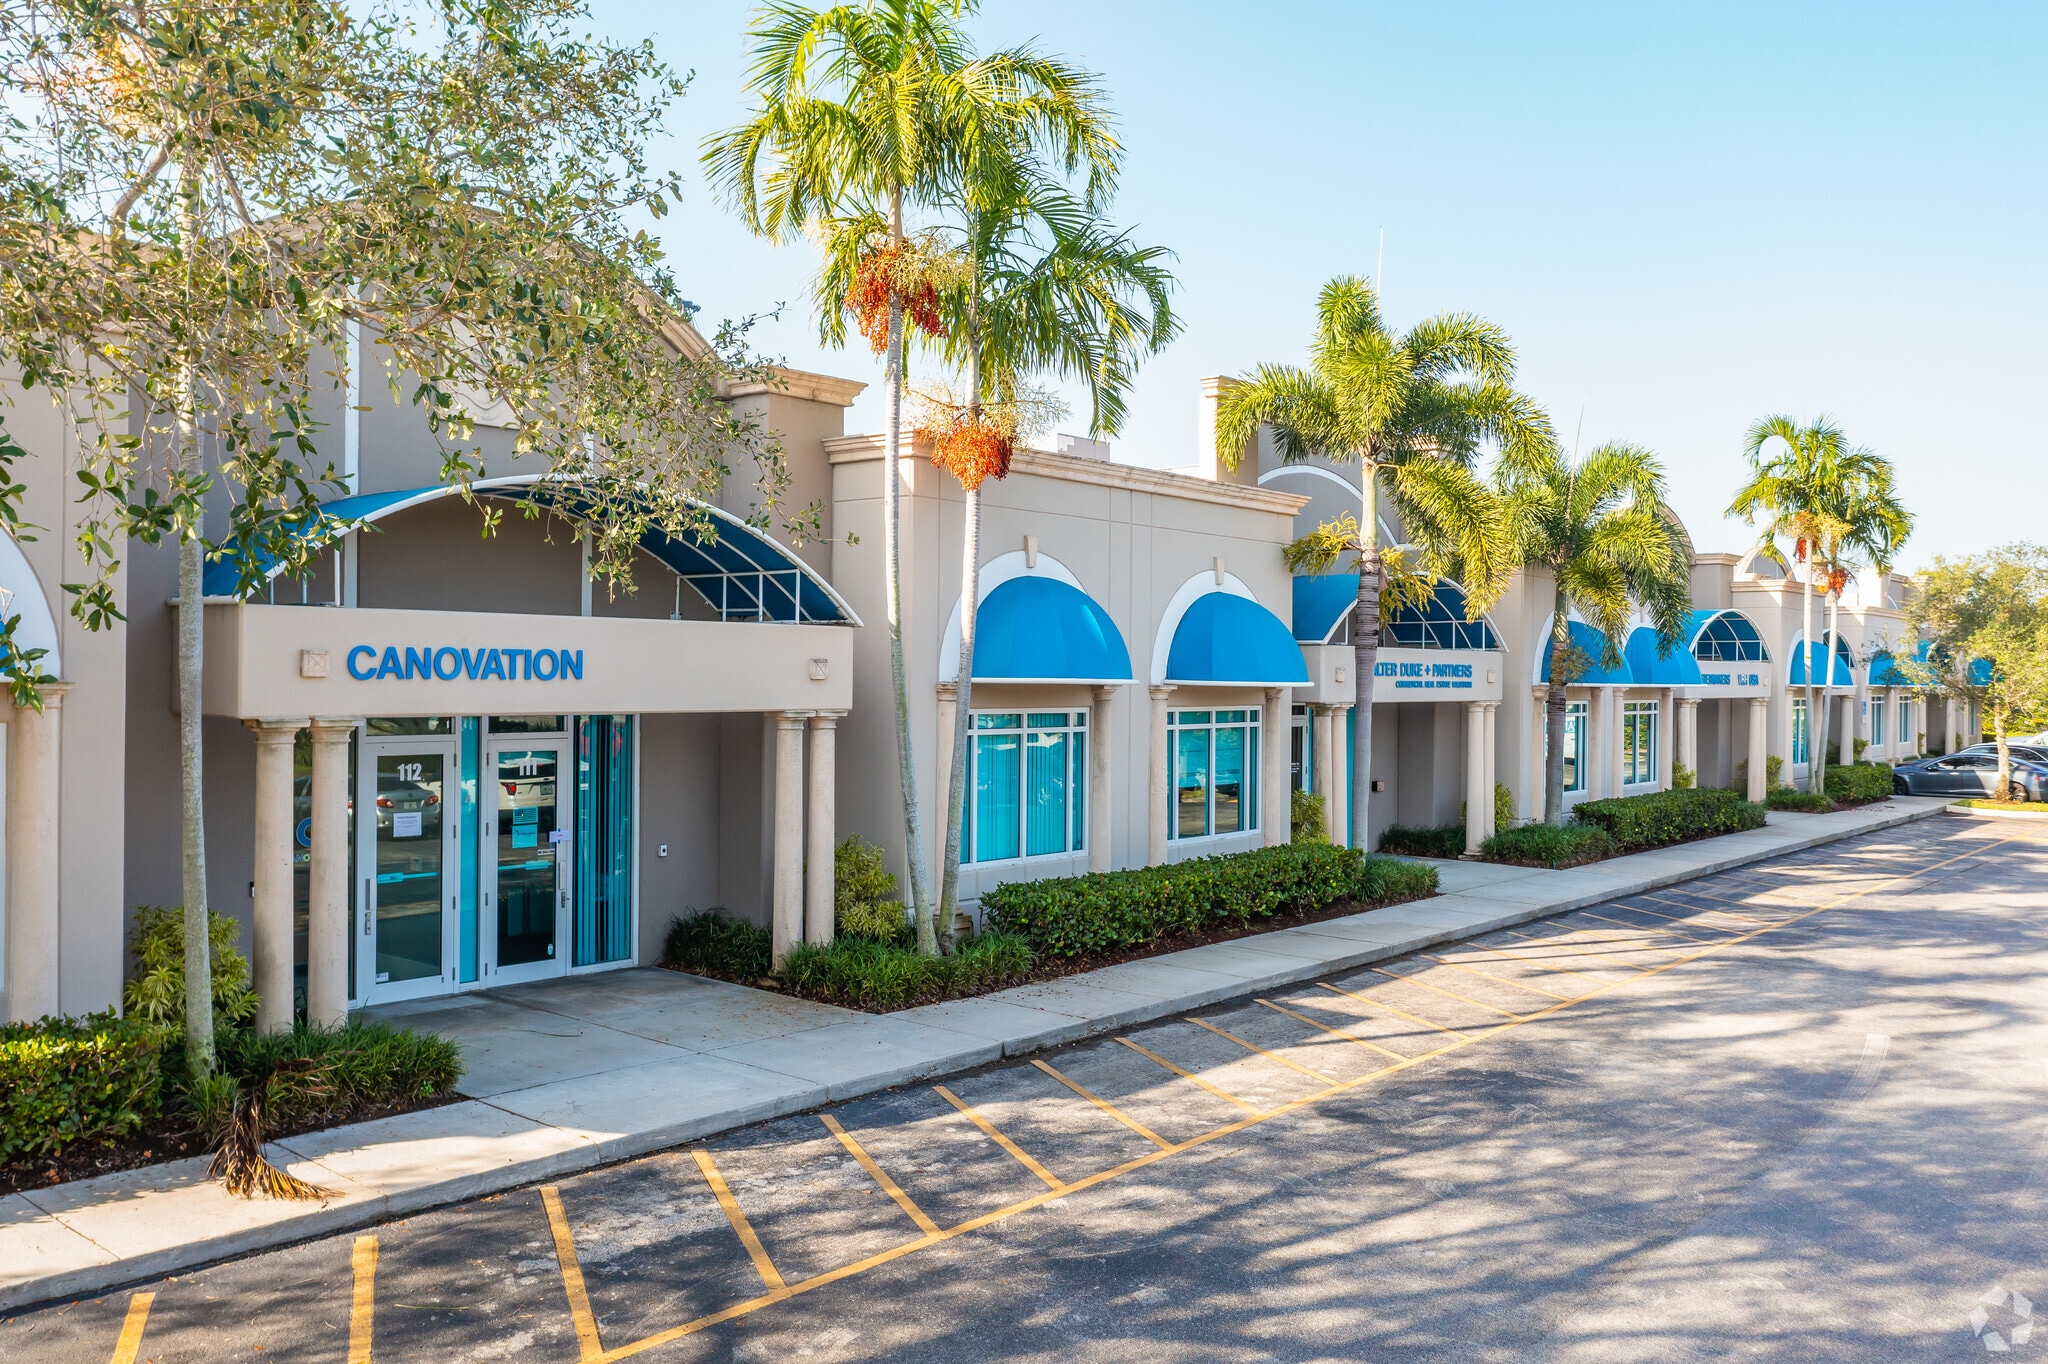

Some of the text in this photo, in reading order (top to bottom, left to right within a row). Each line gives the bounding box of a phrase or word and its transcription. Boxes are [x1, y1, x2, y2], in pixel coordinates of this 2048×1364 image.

[347, 645, 583, 681] CANOVATION
[1399, 662, 1423, 677] DUKE
[1424, 664, 1431, 676] +
[1432, 663, 1473, 678] PARTNERS
[397, 763, 422, 782] 112
[517, 758, 537, 776] 111
